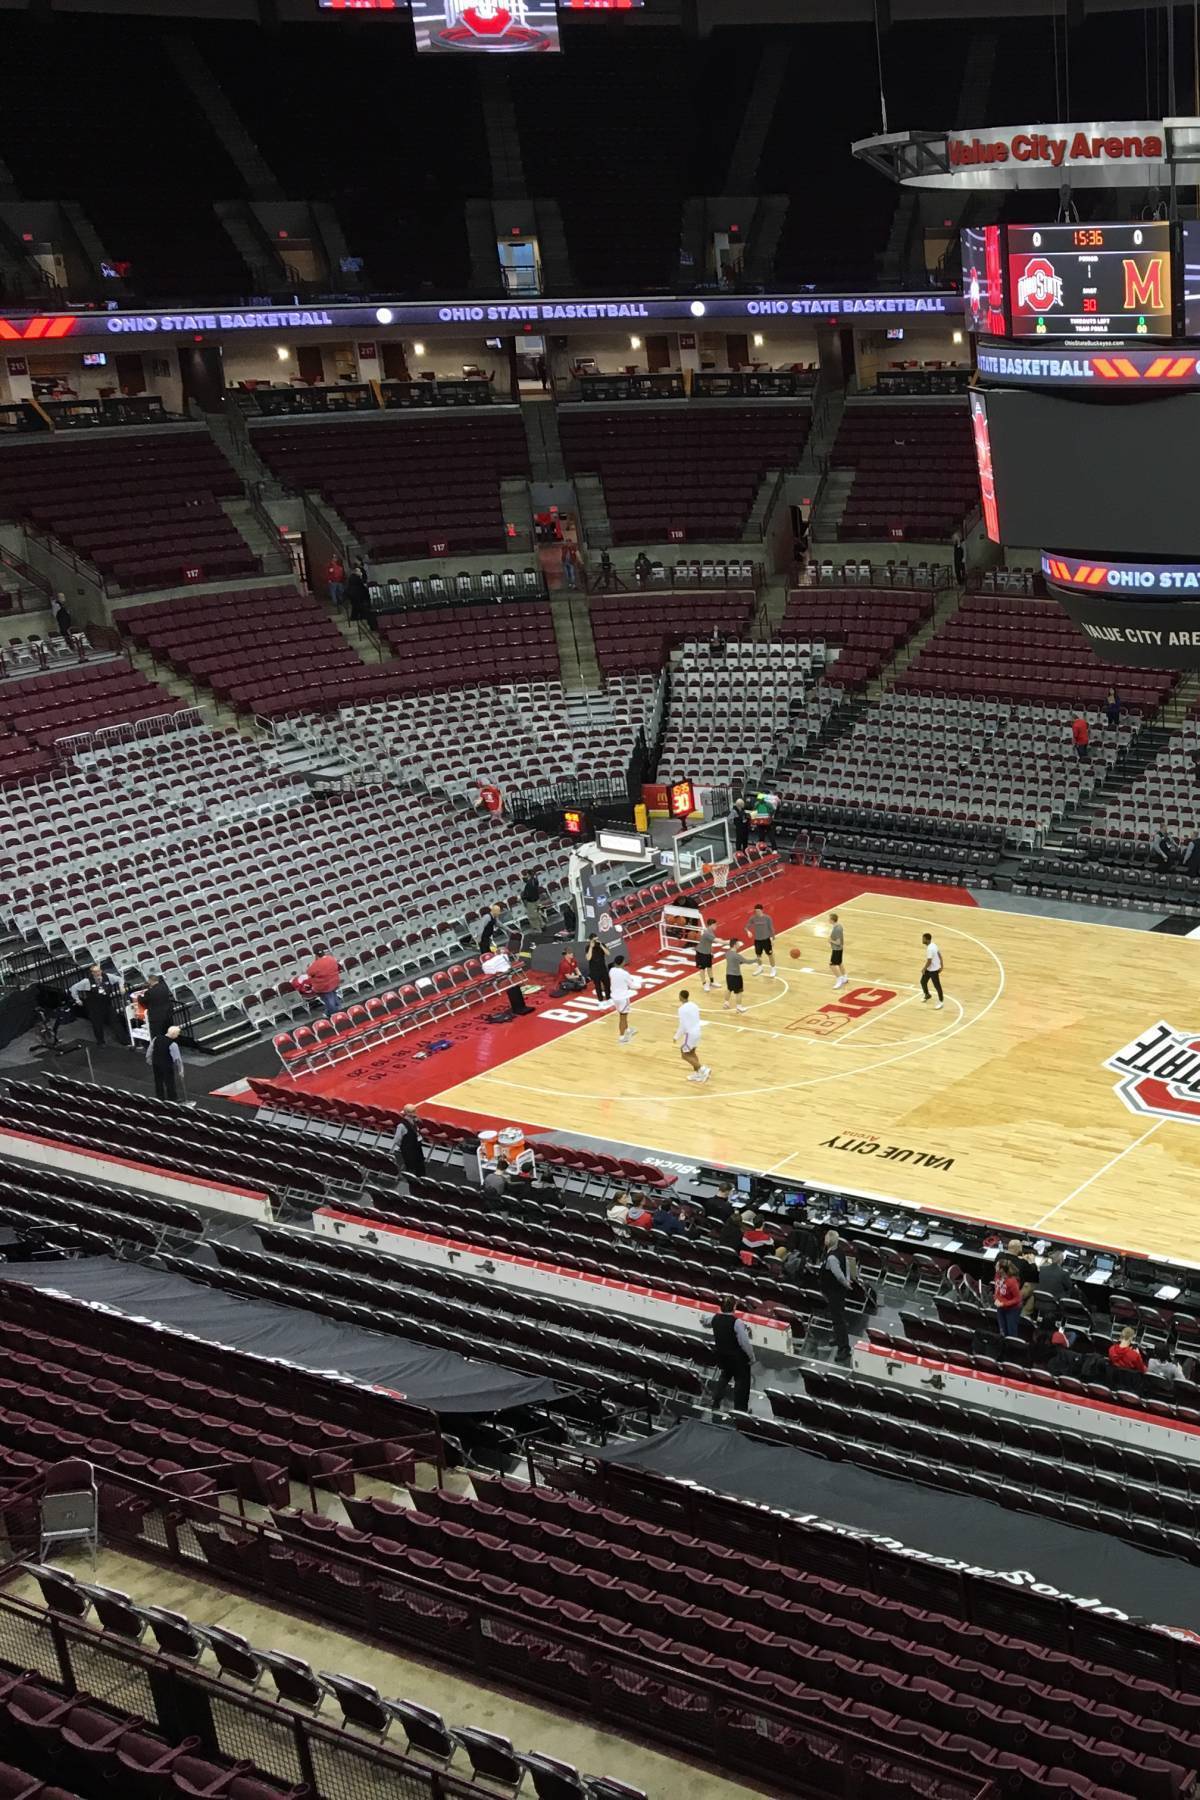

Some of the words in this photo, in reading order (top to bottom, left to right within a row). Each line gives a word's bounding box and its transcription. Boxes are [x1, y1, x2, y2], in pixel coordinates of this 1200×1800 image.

[948, 138, 1009, 165] Value
[1010, 134, 1067, 167] City
[1069, 132, 1163, 159] Arena
[1074, 230, 1104, 245] 15:36
[1133, 229, 1143, 245] 0
[1122, 259, 1164, 309] M
[438, 308, 484, 321] OHIO
[487, 306, 538, 320] STATE
[542, 304, 648, 318] BASKETBALL
[747, 301, 788, 314] OHIO
[791, 300, 840, 313] STATE
[843, 299, 945, 312] BASKETBALL
[1083, 299, 1096, 311] 30
[107, 318, 157, 332] OHIO
[160, 314, 217, 330] STATE
[219, 311, 332, 328] BASKETBALL
[1000, 357, 1094, 377] BASKETBALL
[432, 543, 445, 552] 117
[186, 569, 199, 578] 117
[1107, 570, 1155, 587] OHIO
[1081, 622, 1125, 642] VALUE
[1125, 629, 1162, 646] CITY
[672, 793, 689, 813] 30
[818, 1135, 881, 1155] CITY
[876, 1146, 956, 1171] VALUE
